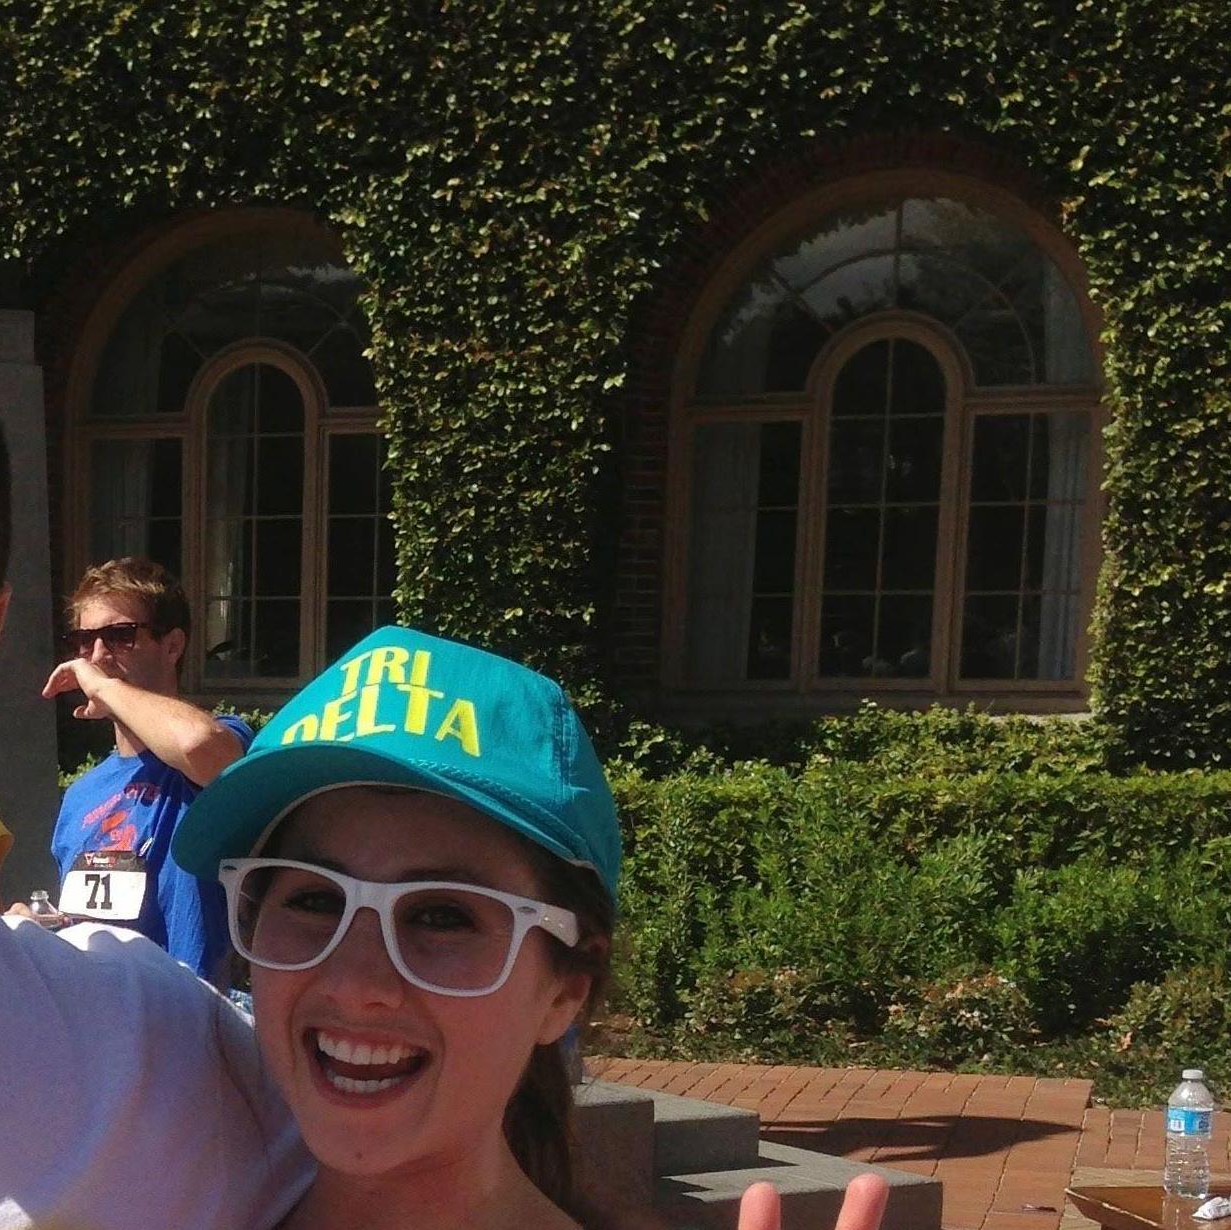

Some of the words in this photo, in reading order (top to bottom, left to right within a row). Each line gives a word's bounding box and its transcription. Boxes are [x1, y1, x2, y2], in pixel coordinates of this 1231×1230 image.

[338, 646, 432, 699] TRI
[281, 684, 481, 758] DELTA
[84, 873, 113, 910] 71
